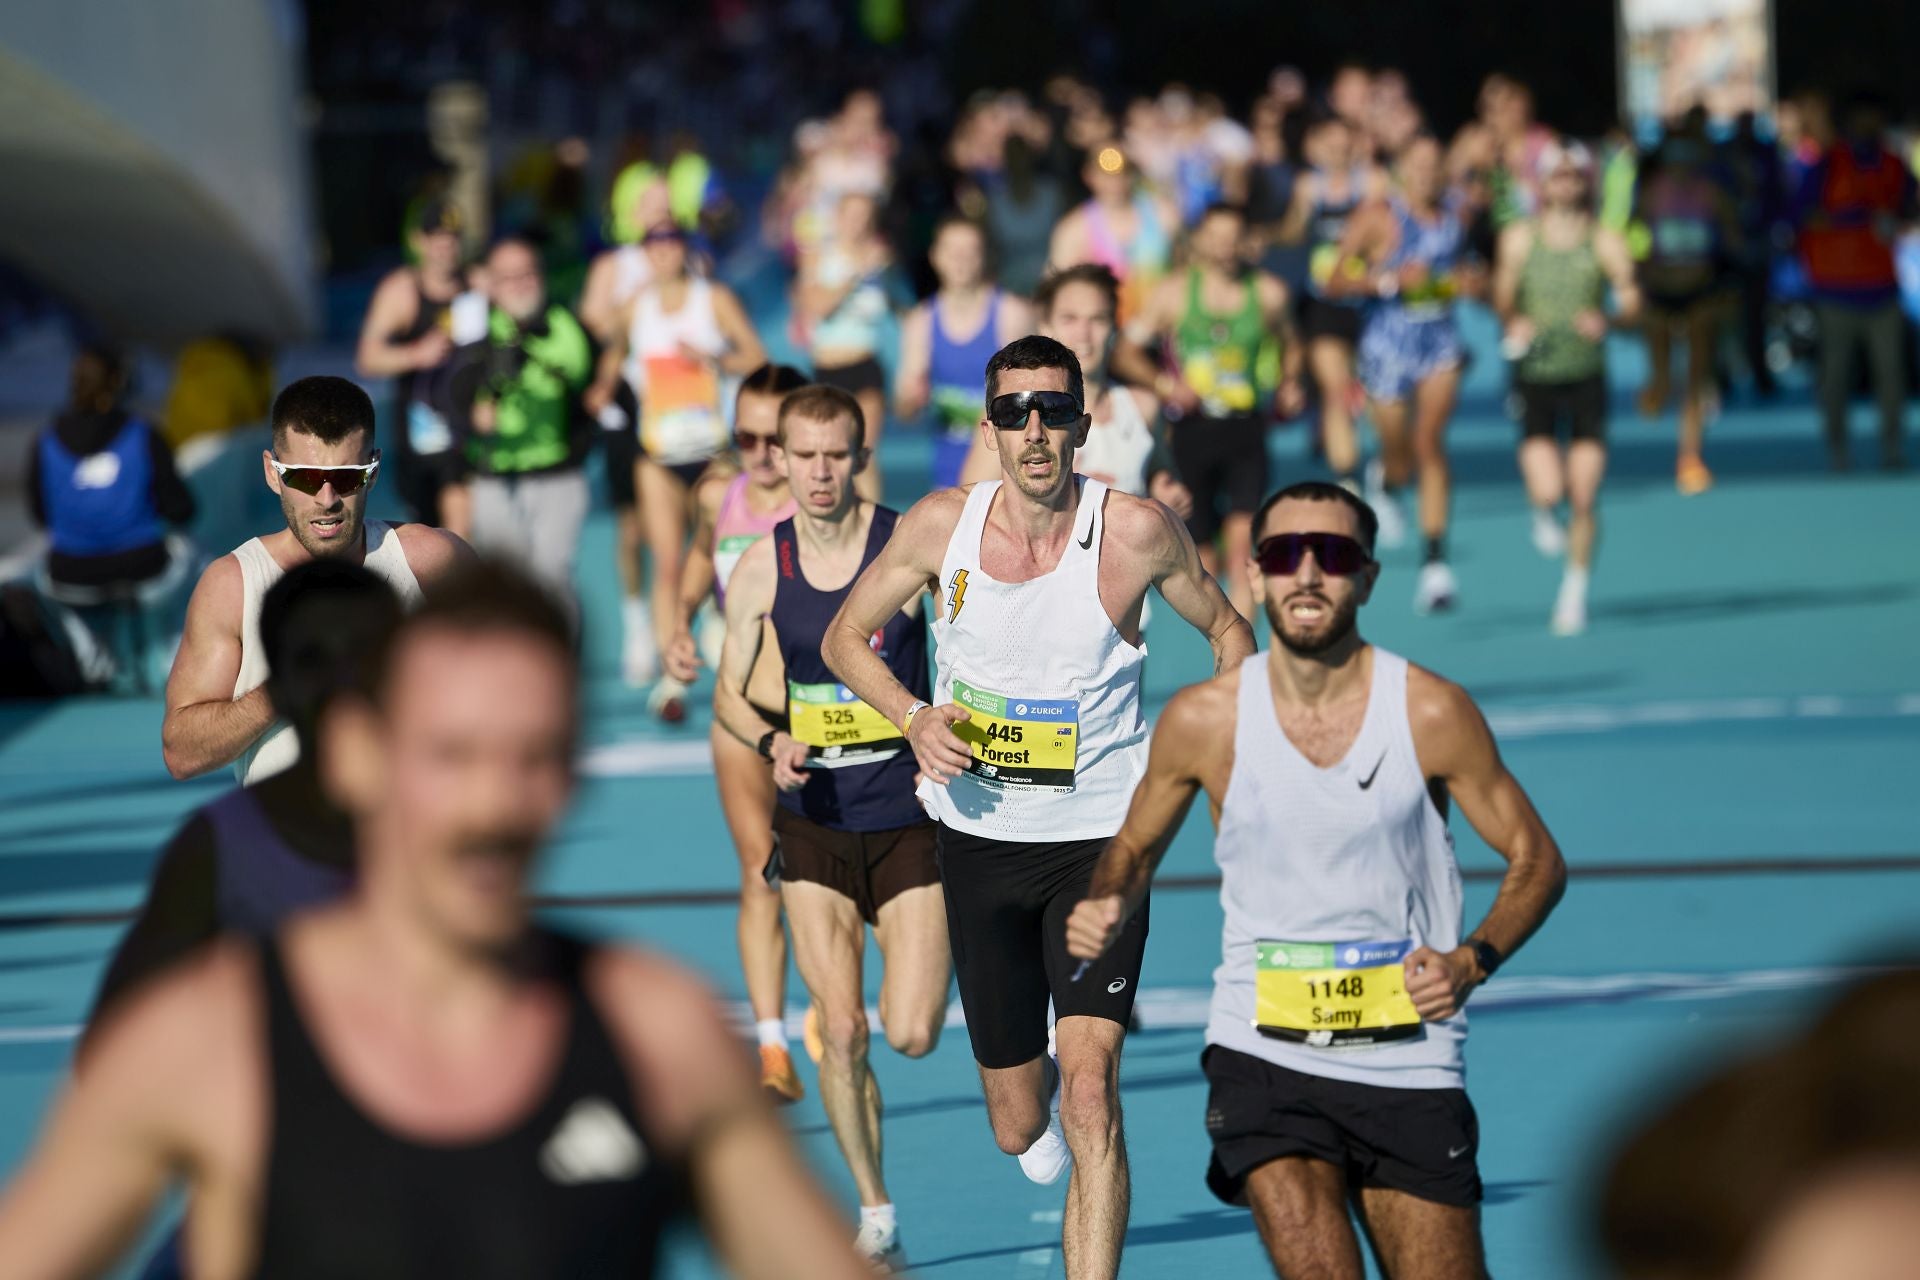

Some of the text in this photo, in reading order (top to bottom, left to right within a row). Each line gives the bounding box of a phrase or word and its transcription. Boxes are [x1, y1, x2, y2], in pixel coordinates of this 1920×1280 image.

[823, 709, 854, 725] 525
[973, 702, 998, 713] ALFONSO
[1030, 706, 1064, 715] ZURICH
[986, 722, 1023, 743] 445
[981, 742, 1030, 764] Forest
[1307, 976, 1364, 998] 1148
[1312, 1007, 1363, 1028] Samy
